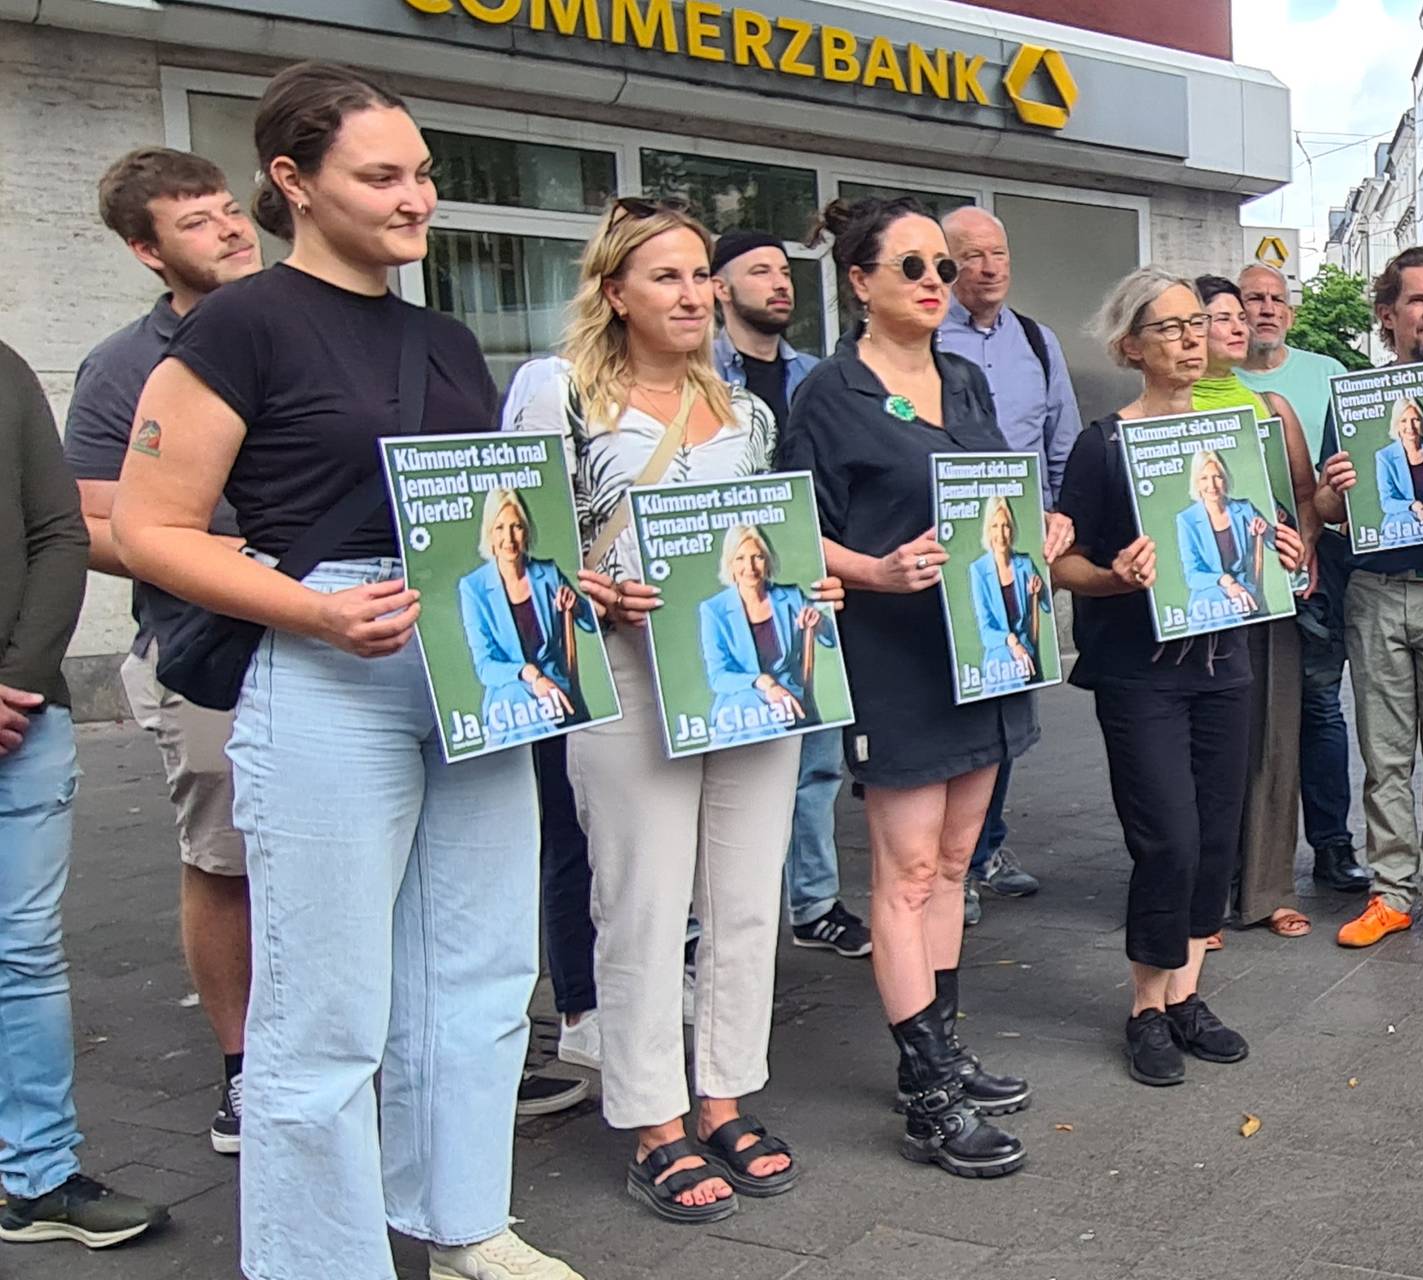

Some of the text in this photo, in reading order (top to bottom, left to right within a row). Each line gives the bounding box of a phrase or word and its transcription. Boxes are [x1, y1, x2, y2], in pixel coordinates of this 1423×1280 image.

[404, 0, 990, 106] MMERZBANK
[1335, 374, 1391, 394] Kümmert
[1392, 372, 1417, 388] sich
[1338, 391, 1383, 411] jemand
[1384, 390, 1401, 402] um
[1339, 404, 1385, 422] Viertel?
[1127, 415, 1241, 444] Kümmert sich mal
[394, 440, 548, 472] Kümmert sich mal
[1131, 435, 1237, 463] jemand um mein
[1134, 458, 1184, 478] Viertel?
[399, 466, 542, 502] jemand um mein
[638, 481, 793, 515] Kümmert sich mal
[404, 497, 474, 525] Viertel?
[642, 506, 785, 540] jemand um mein
[645, 534, 714, 559] Viertel?
[1358, 526, 1384, 544] Ja,
[1163, 592, 1251, 627] Ja, Clara!
[451, 689, 564, 743] Ja, Clara!
[676, 696, 795, 742] Ja, Clara!
